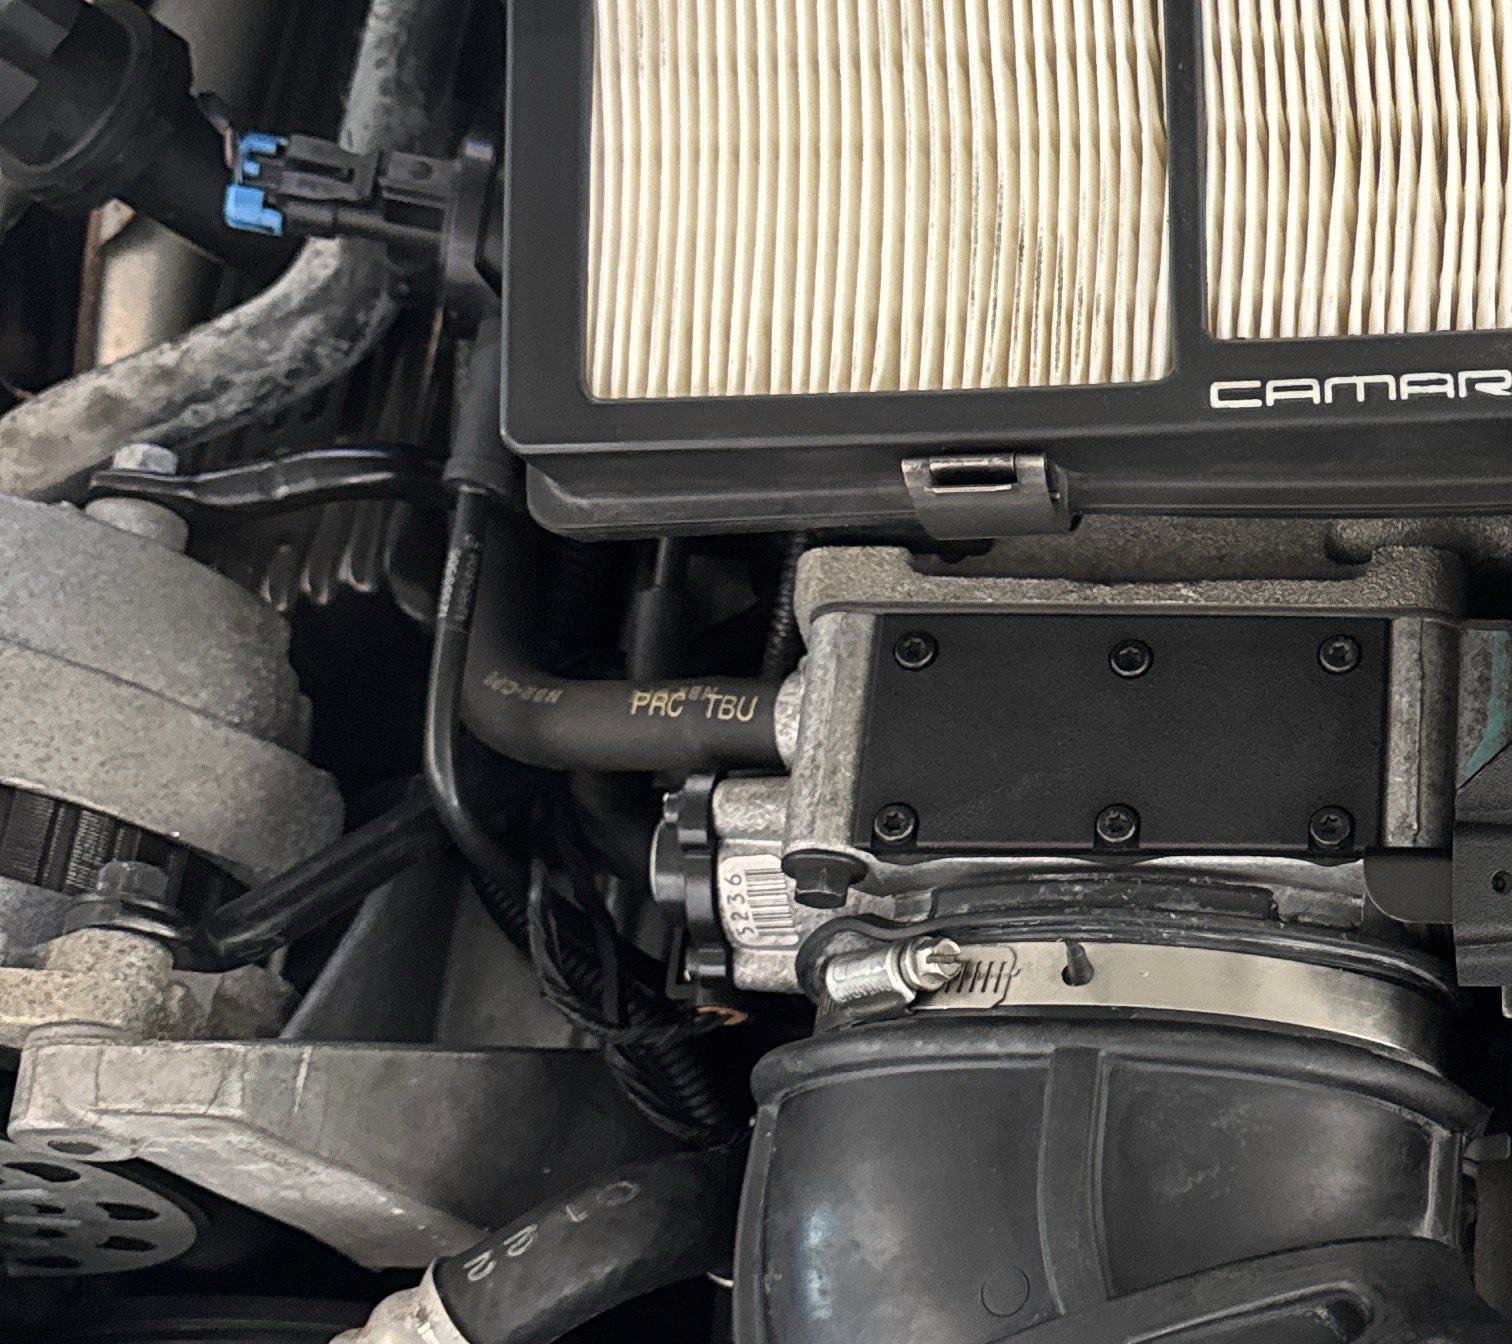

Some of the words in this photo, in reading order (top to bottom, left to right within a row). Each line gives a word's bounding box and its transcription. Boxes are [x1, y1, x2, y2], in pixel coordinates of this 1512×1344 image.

[629, 690, 687, 718] PRC
[704, 692, 758, 723] TBU
[724, 873, 755, 936] 5236
